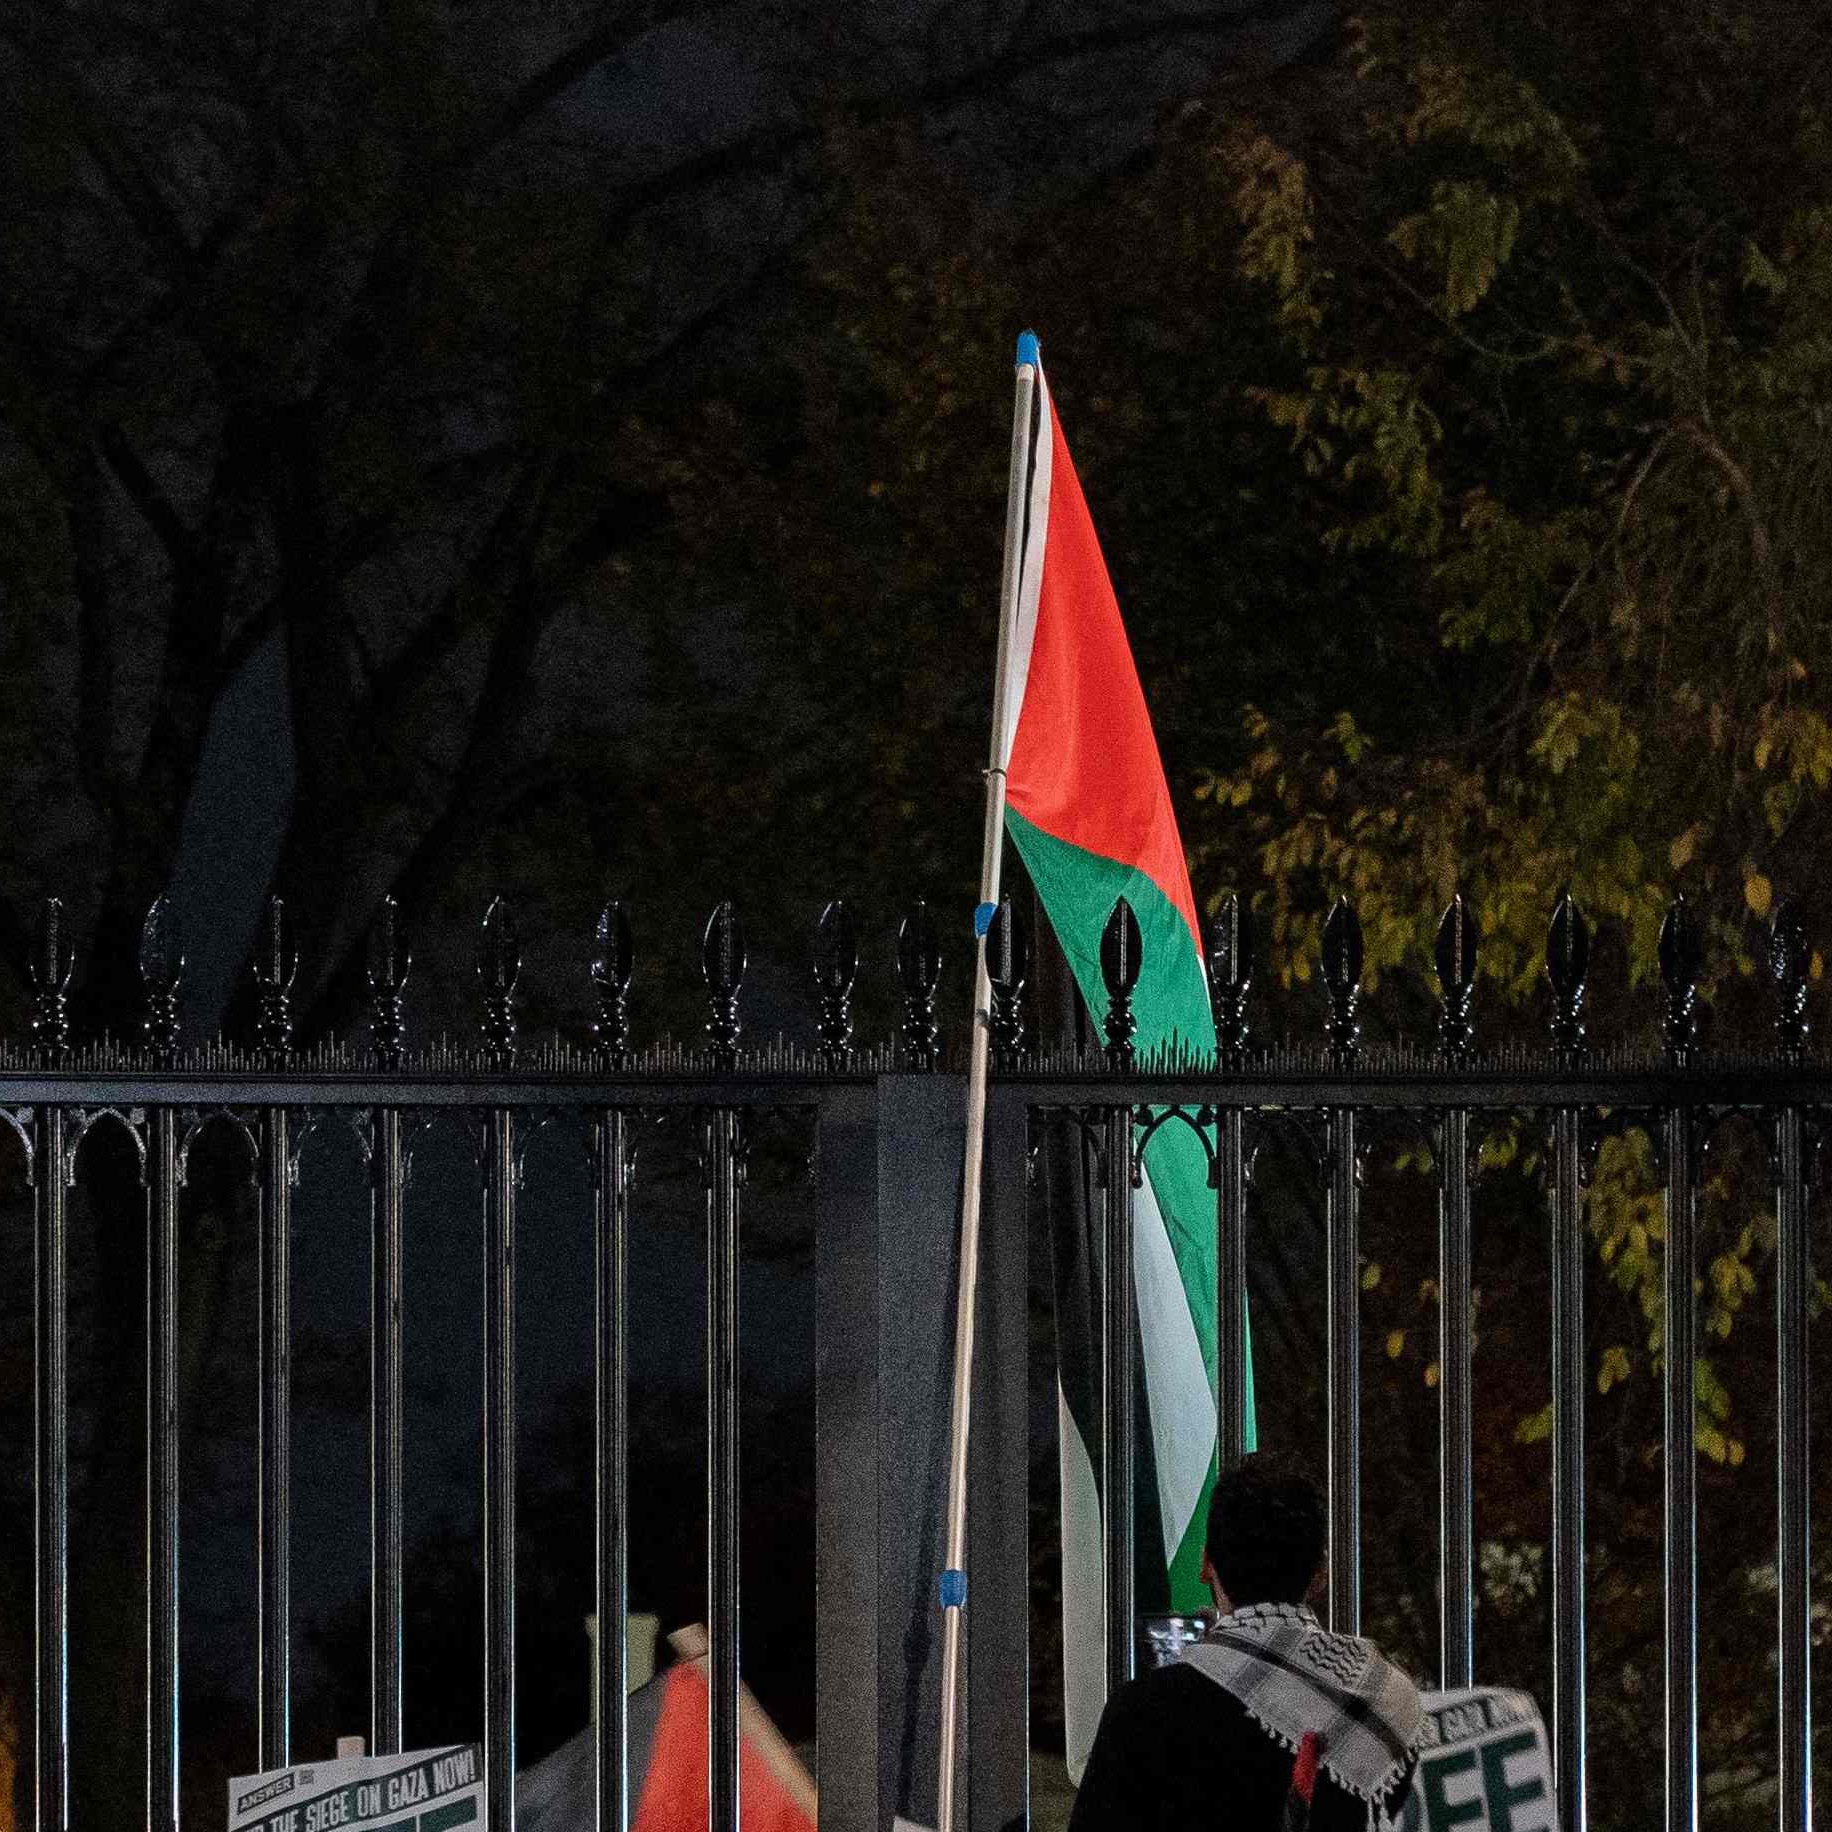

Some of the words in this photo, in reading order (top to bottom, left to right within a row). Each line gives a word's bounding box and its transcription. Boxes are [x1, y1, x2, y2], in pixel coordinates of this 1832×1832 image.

[240, 1776, 293, 1811] ANSWER
[357, 1785, 381, 1817] ON
[388, 1767, 430, 1810] GAZA
[433, 1748, 477, 1794] NOW!
